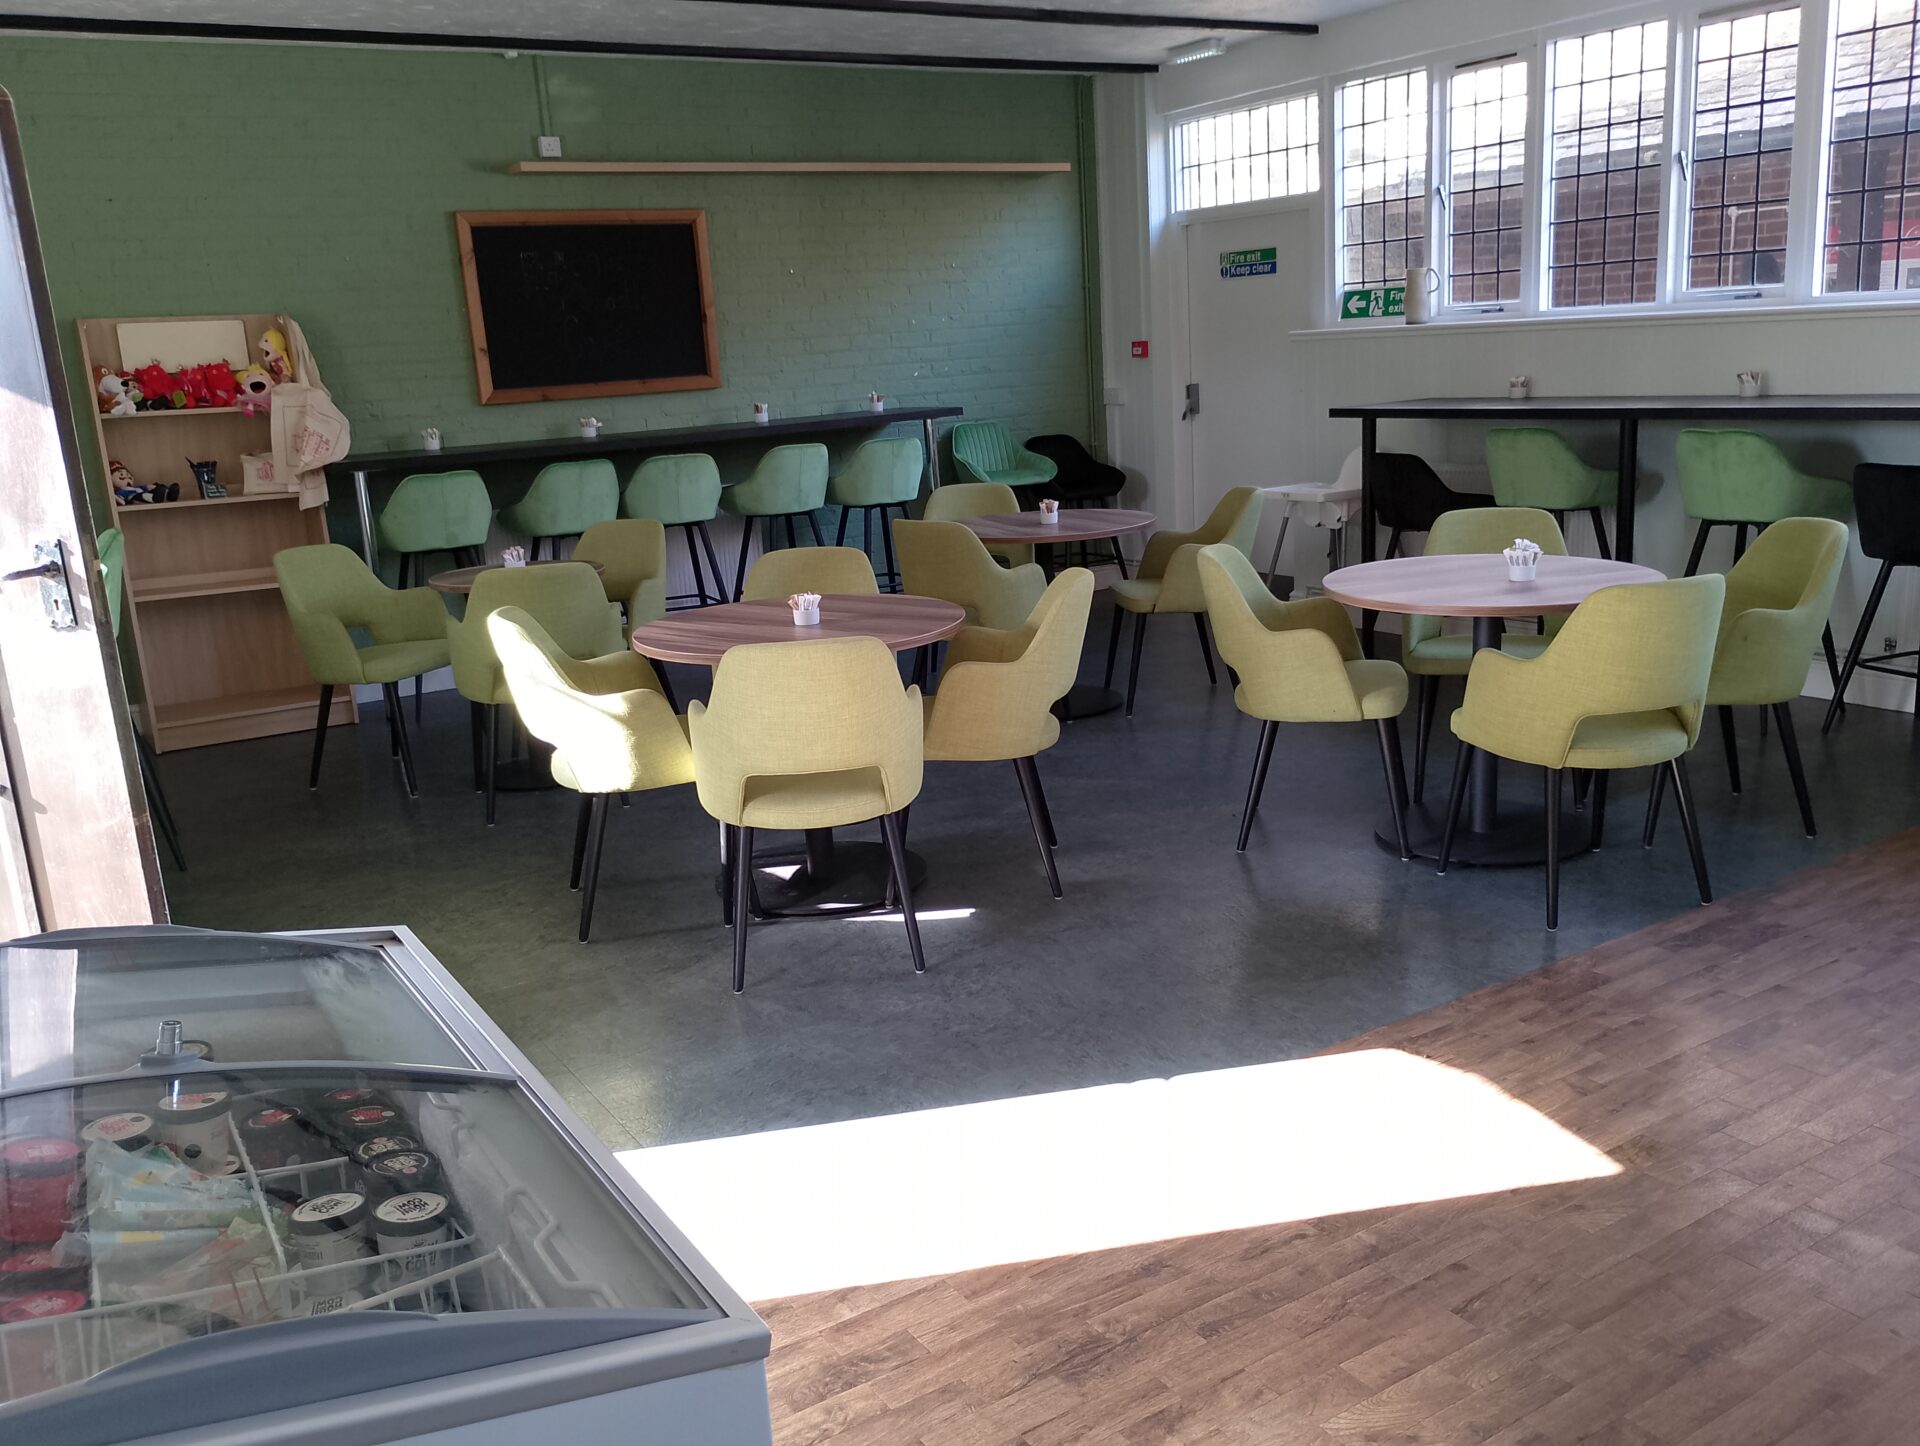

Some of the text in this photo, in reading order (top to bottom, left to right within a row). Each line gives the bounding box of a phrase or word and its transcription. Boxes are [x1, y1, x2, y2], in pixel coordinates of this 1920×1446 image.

[1230, 251, 1261, 263] Fire exit
[1230, 263, 1271, 277] Keep clear
